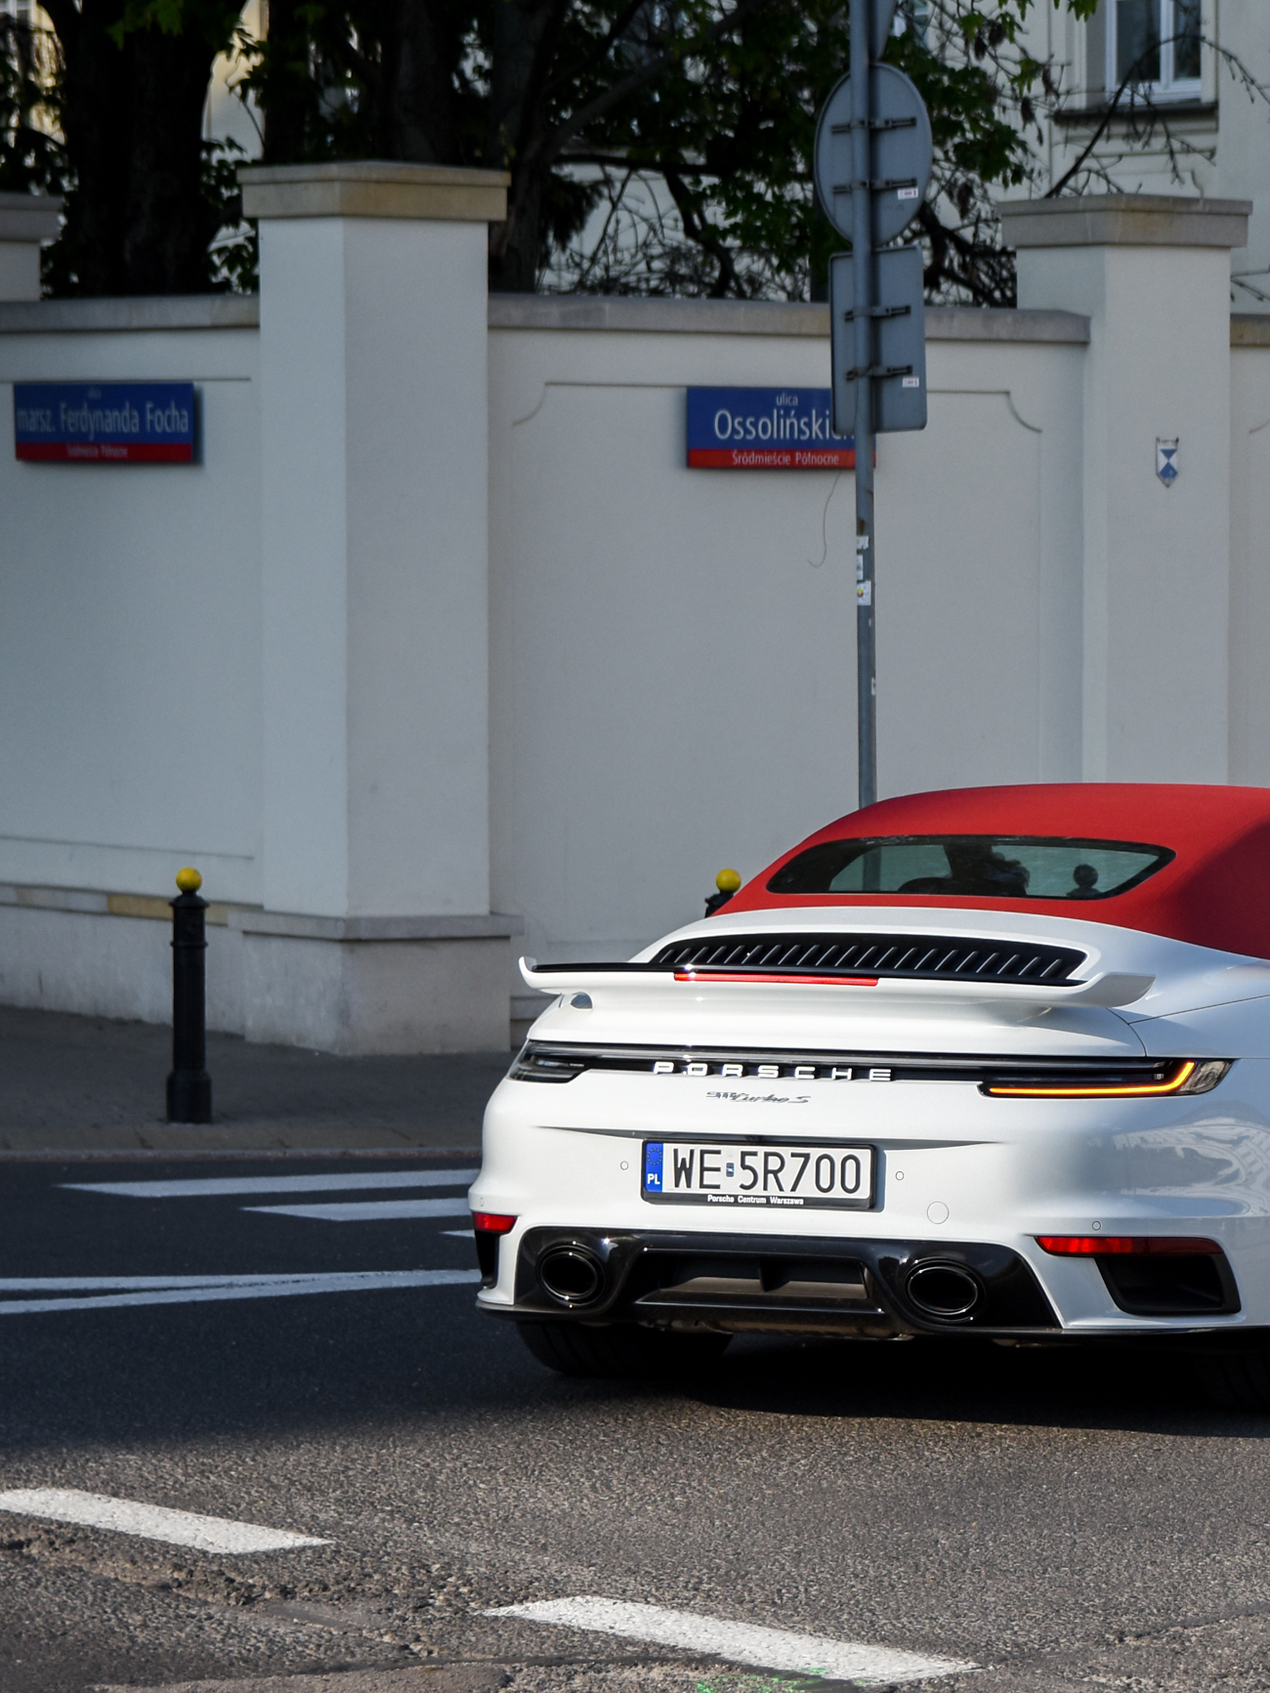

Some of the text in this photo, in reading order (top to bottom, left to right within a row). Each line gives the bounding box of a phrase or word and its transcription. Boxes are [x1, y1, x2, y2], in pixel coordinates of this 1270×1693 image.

[775, 393, 798, 406] ulica
[60, 401, 140, 441] Ferdynanda
[145, 400, 190, 433] Focha
[714, 408, 856, 440] Ossoliński
[732, 449, 840, 466] Śródmieście Północne
[653, 1061, 892, 1082] PORSCHE
[647, 1173, 660, 1185] PL
[673, 1148, 861, 1194] WE 5R700
[707, 1194, 804, 1205] Porsche Centrum Warszawa
